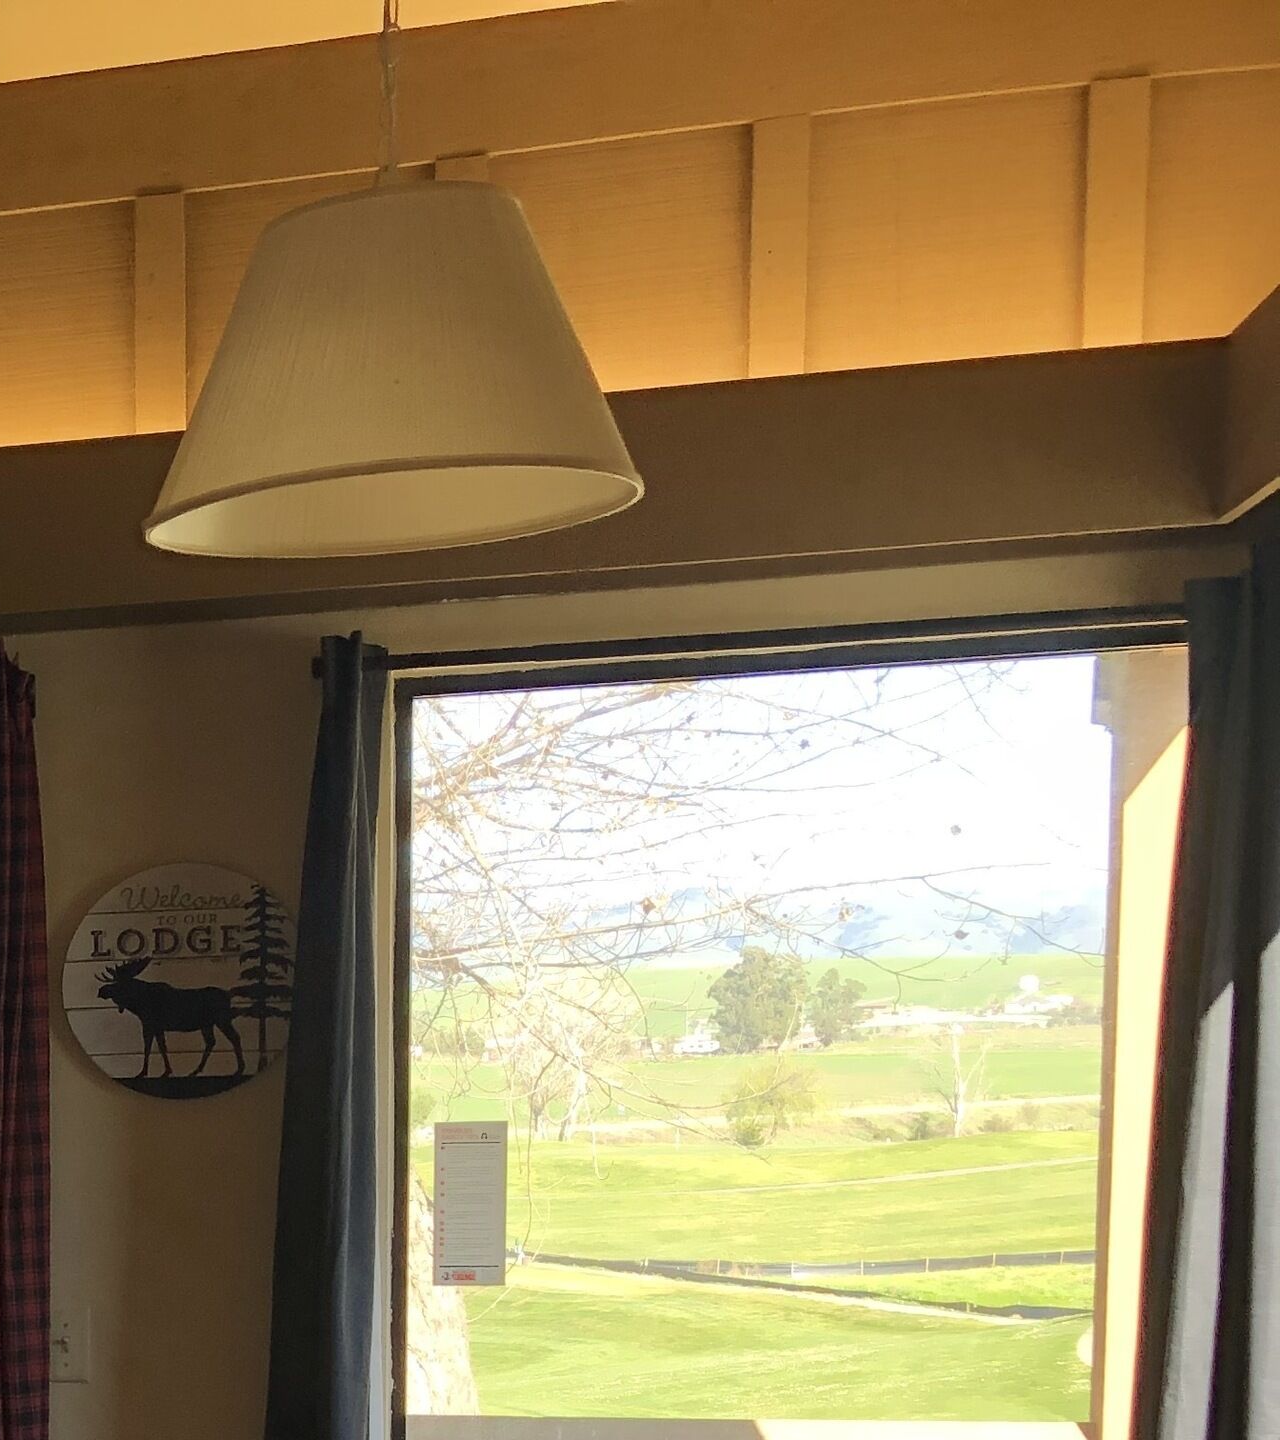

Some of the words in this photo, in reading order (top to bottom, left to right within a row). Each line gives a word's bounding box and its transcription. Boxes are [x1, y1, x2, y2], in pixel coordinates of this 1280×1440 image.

[120, 884, 245, 911] Welcome
[157, 915, 177, 926] TO
[184, 913, 218, 925] OUR
[91, 925, 242, 957] LODGE
